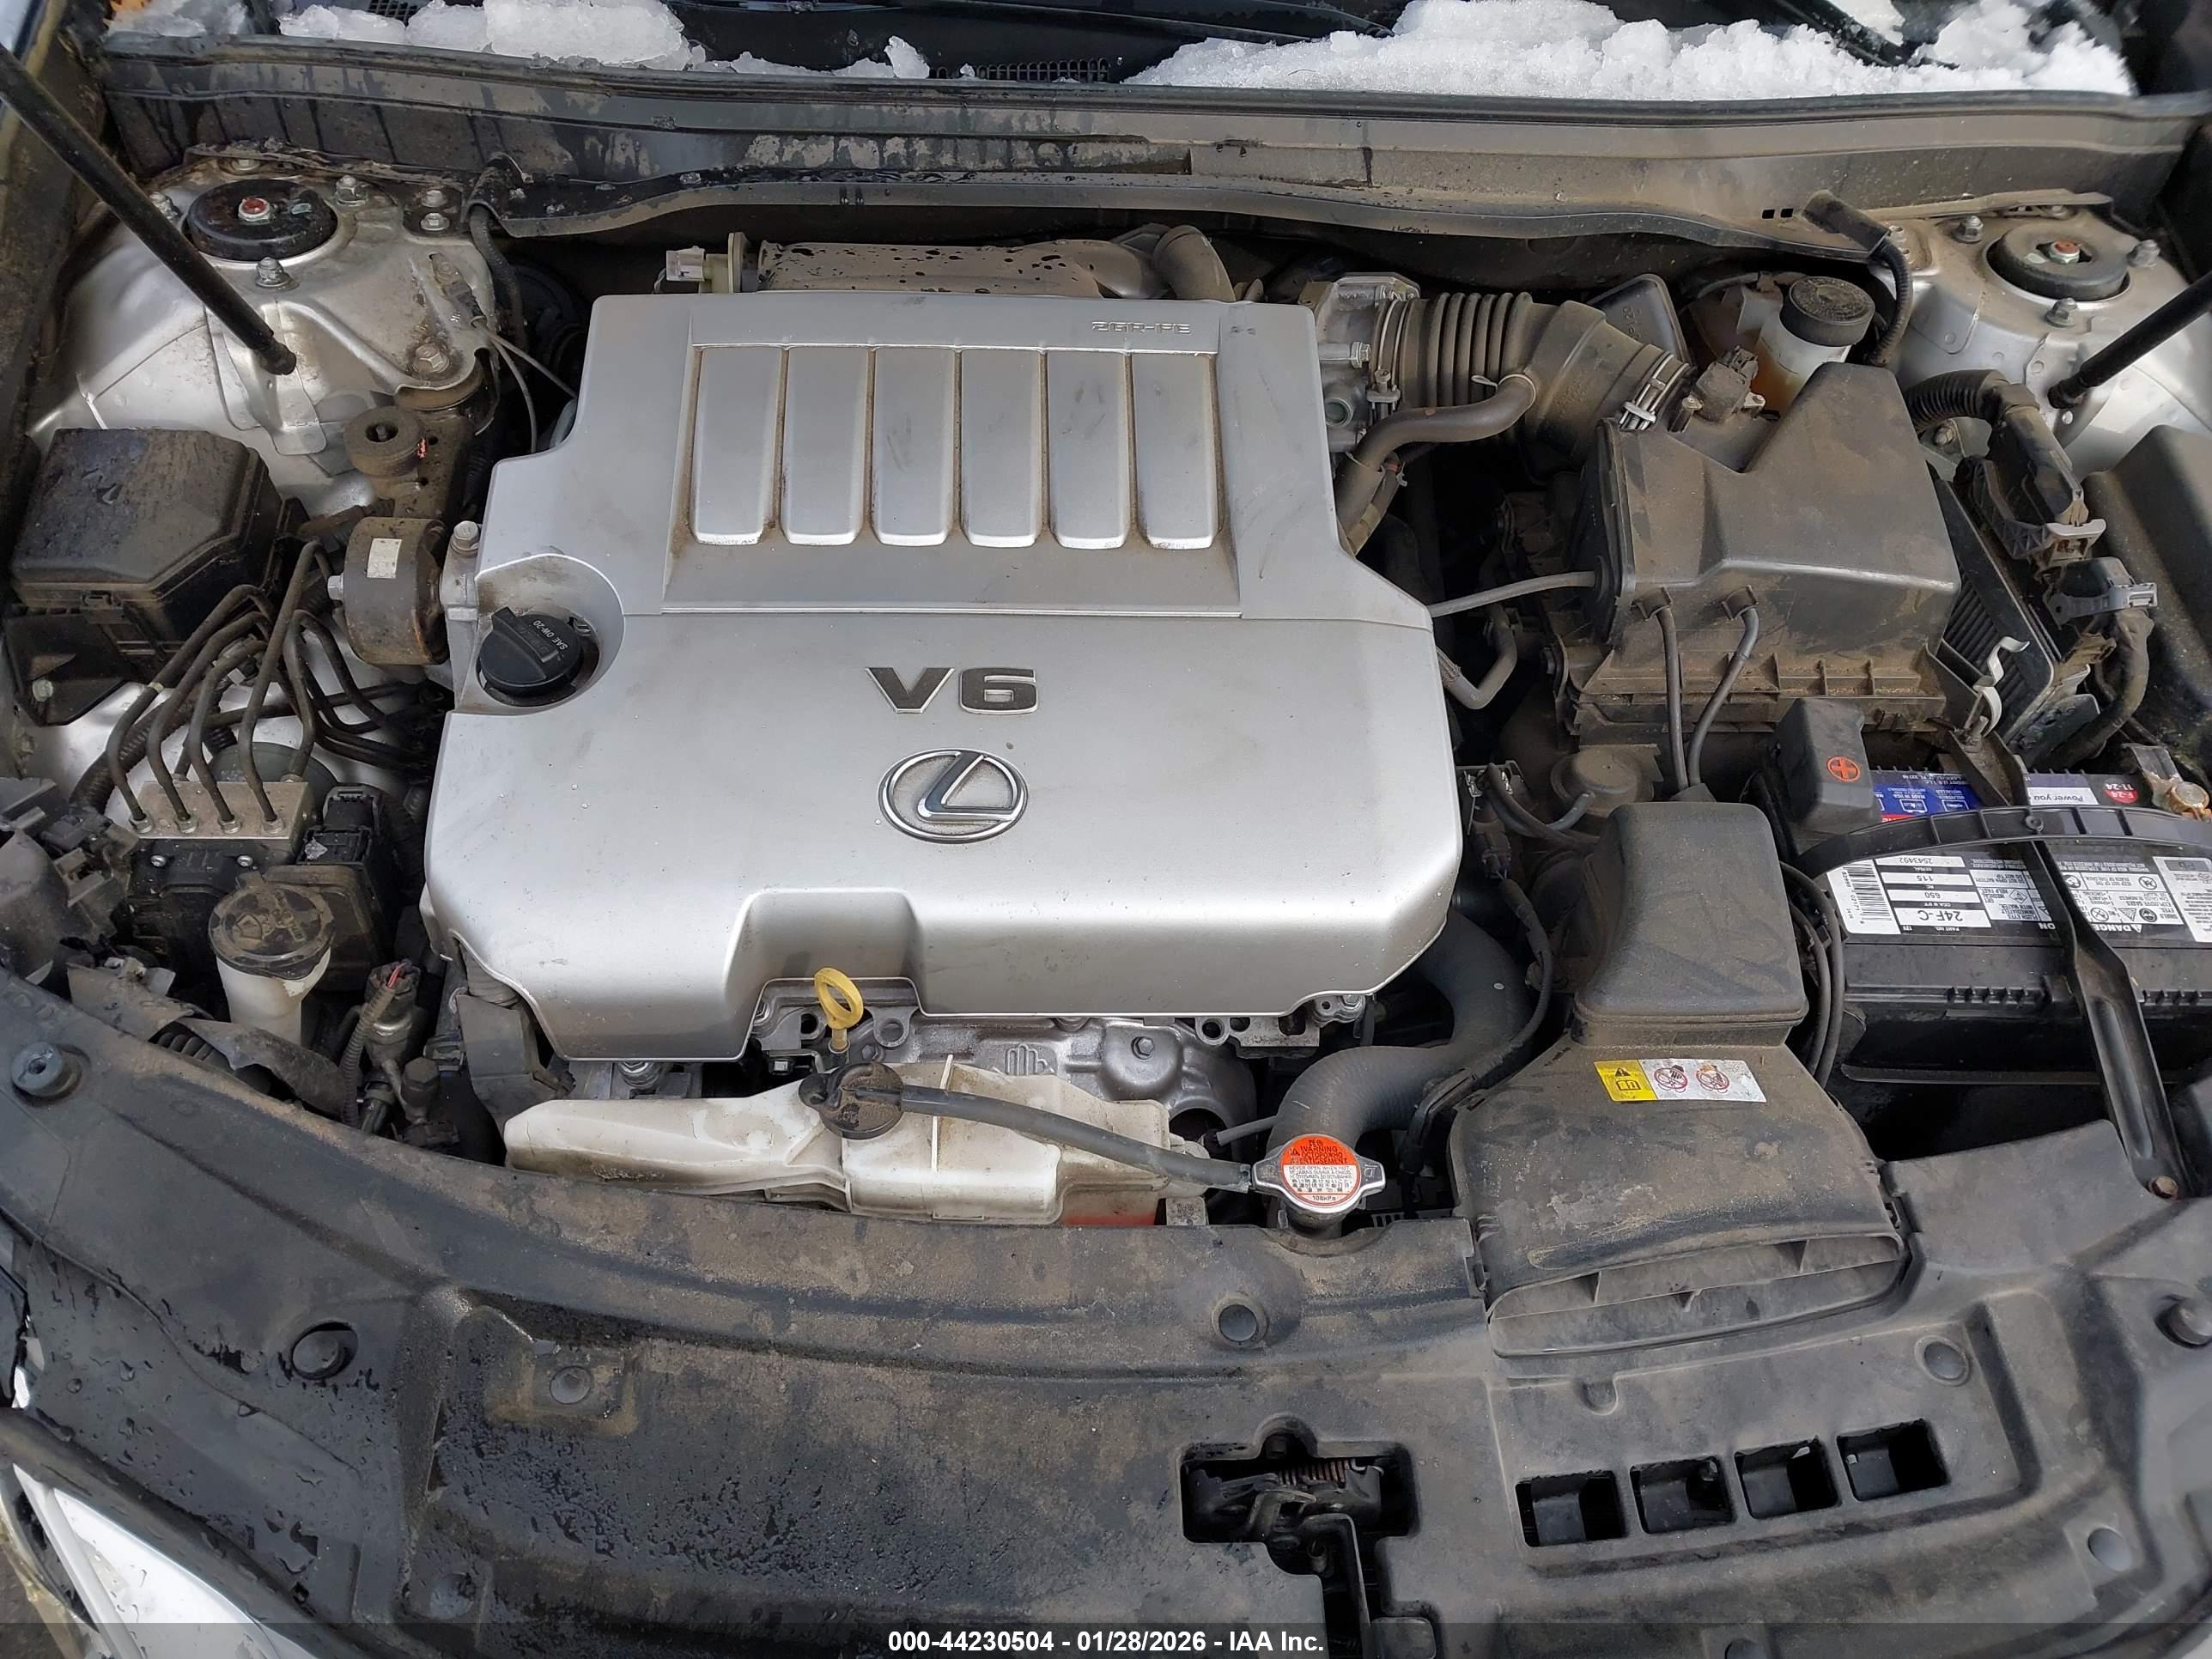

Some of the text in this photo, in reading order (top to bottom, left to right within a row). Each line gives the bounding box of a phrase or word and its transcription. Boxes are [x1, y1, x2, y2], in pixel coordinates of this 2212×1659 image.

[552, 636, 568, 650] SAE
[866, 667, 1038, 715] V6
[1917, 910, 1963, 921] 24F-C
